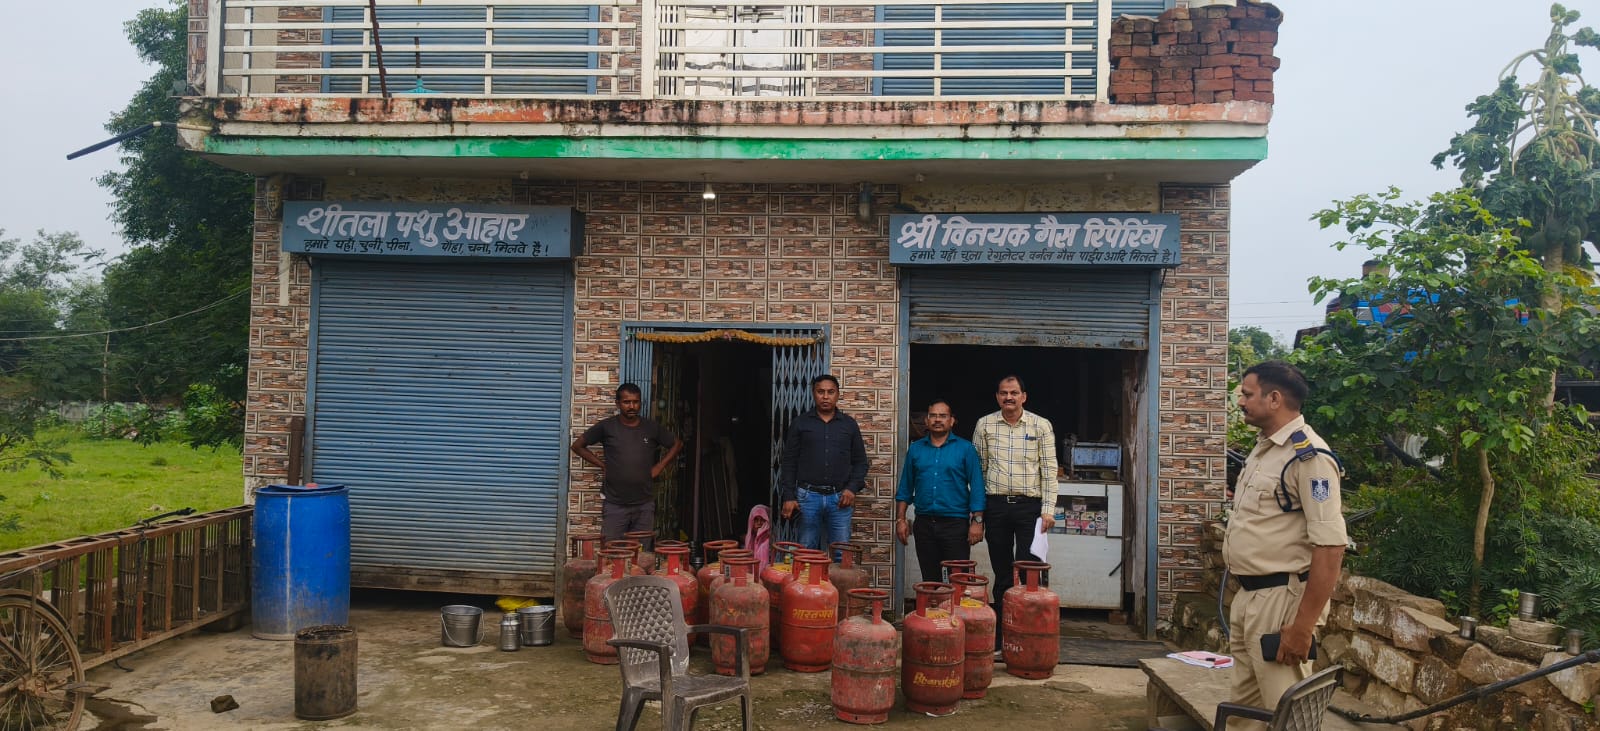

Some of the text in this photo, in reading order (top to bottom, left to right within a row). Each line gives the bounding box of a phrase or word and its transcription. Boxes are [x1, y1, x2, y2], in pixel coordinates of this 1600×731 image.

[297, 204, 529, 247] शीतला पशु आहार
[897, 214, 1168, 249] श्री विनयक गैस रिपेरिंग
[304, 237, 329, 252] हमारे
[495, 241, 528, 254] मिलते
[909, 248, 936, 262] हमारे
[1056, 248, 1076, 261] गैस
[1104, 249, 1128, 263] आदि
[1129, 249, 1159, 262] मिलते
